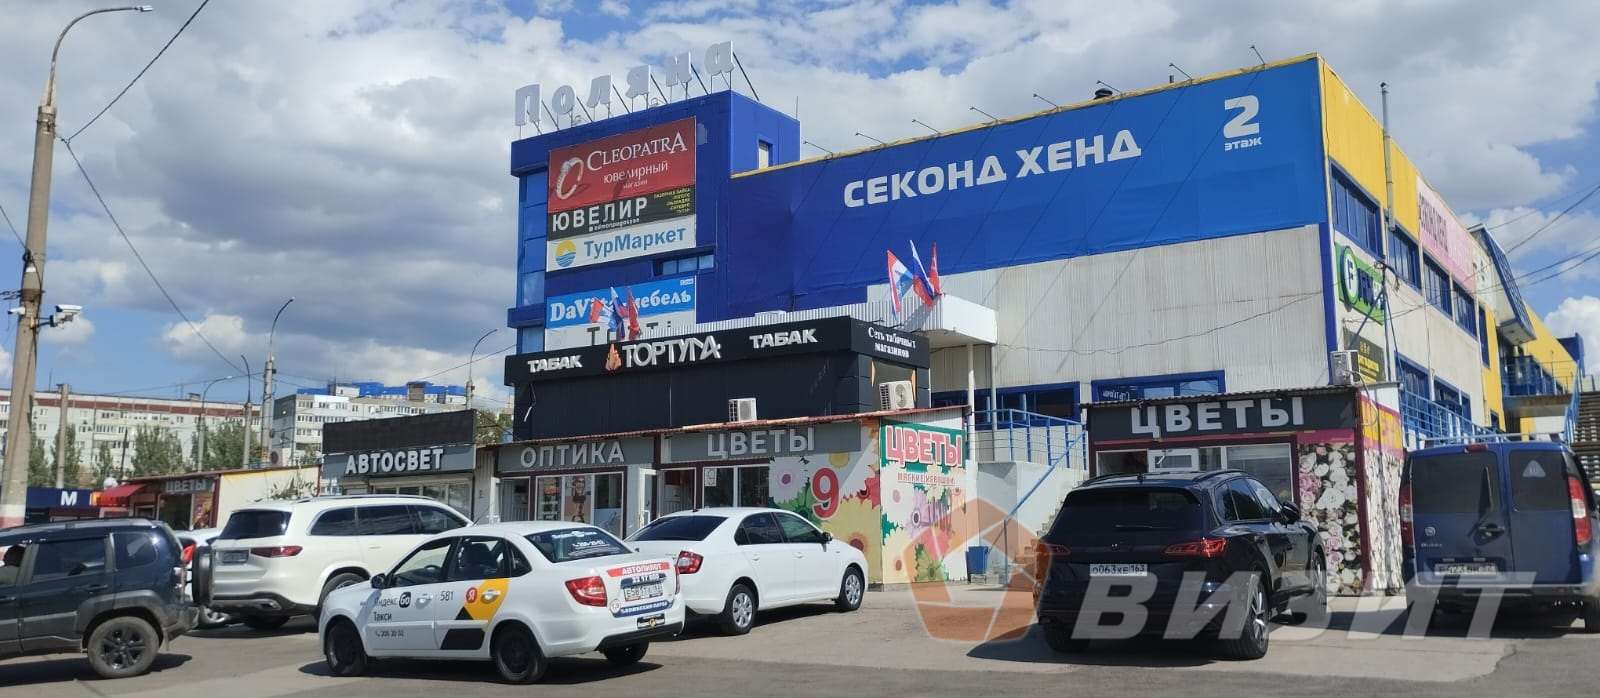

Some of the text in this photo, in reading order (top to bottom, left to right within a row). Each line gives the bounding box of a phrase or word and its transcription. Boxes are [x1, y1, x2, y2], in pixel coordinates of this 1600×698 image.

[1223, 94, 1260, 139] 2
[587, 130, 688, 171] CLEOPATRA
[603, 159, 668, 184] ювелирный
[843, 128, 1141, 208] СЕКОНД ХЕНД
[552, 197, 648, 232] ЮВЕЛИР
[584, 227, 686, 259] ТурМаркет
[621, 335, 721, 368] ТОРТУГА
[749, 328, 818, 349] ТАБАК
[527, 354, 583, 373] ТАБАК
[1131, 396, 1305, 440] ЦВЕТЫ
[520, 440, 626, 469] ОПТИКА
[706, 426, 815, 459] ЦВЕТЫ
[885, 424, 963, 468] ЦВЕТЫ
[345, 448, 444, 475] АВТОСВЕТ
[165, 479, 207, 493] ЦВЕТЫ
[812, 467, 840, 519] 9
[1131, 564, 1145, 573] 163
[440, 590, 454, 601] 581
[466, 588, 475, 601] Я
[373, 611, 392, 621] Такси
